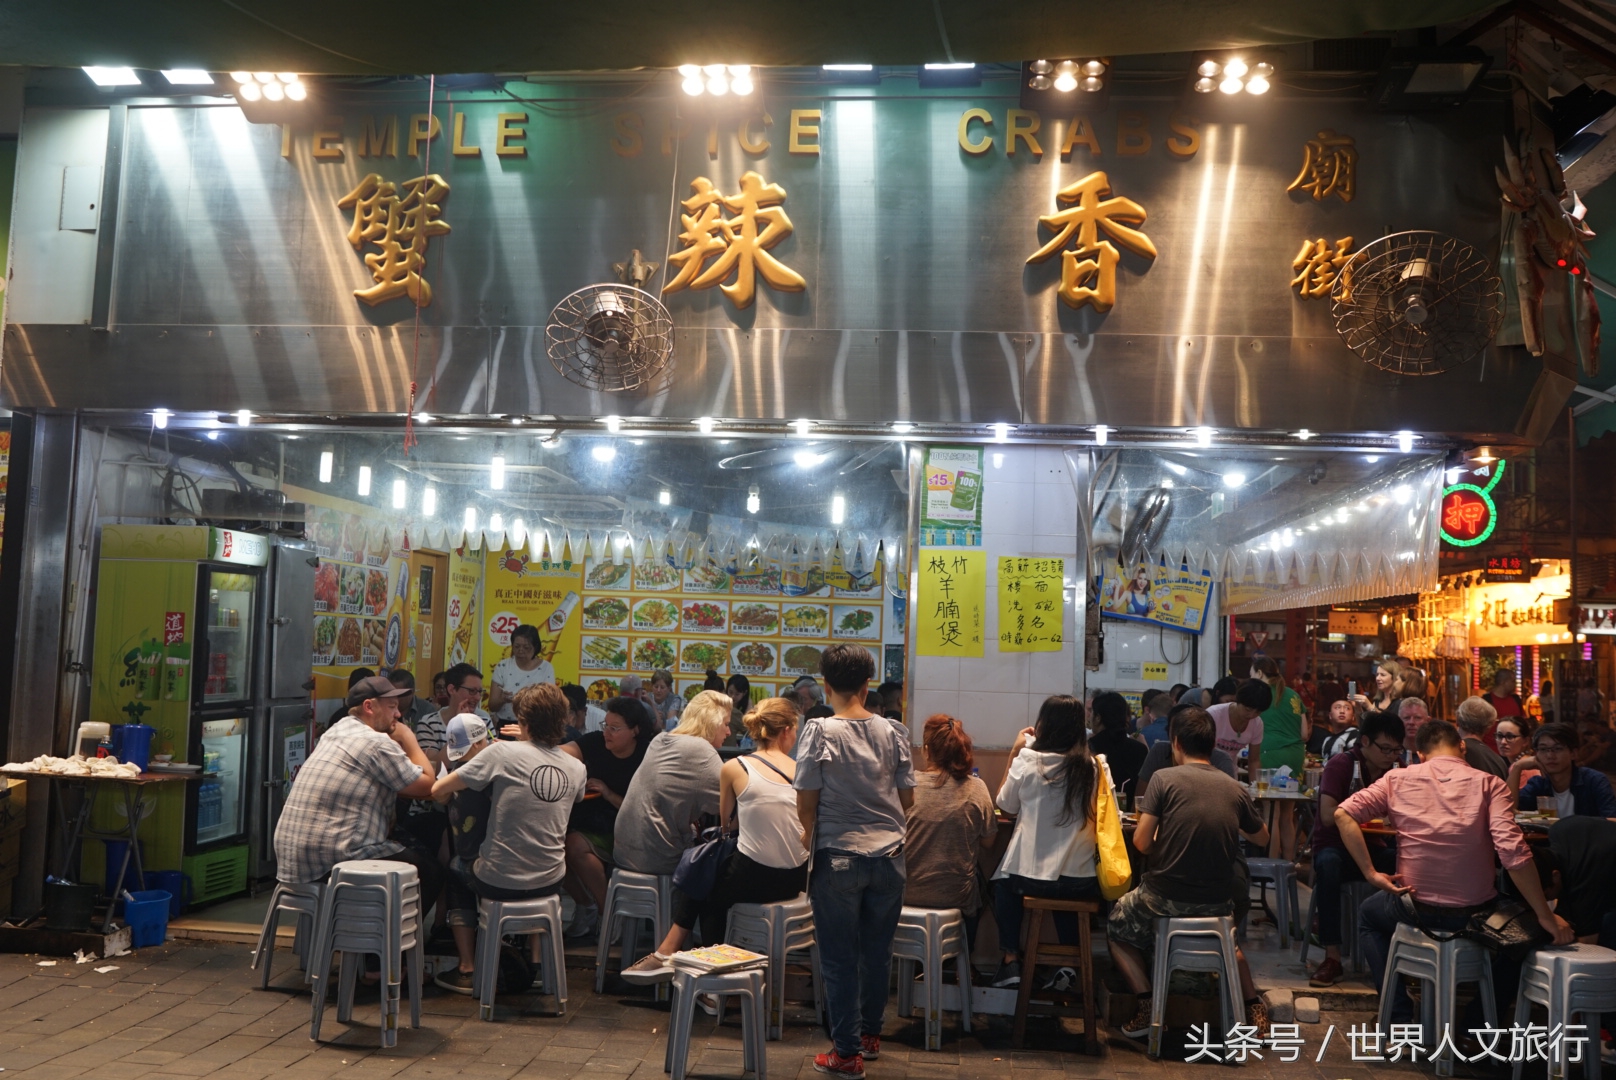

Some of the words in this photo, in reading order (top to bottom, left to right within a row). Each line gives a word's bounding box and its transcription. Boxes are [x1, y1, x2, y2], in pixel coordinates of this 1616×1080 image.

[610, 109, 822, 158] SPICE
[957, 107, 1201, 159] CRABS
[1445, 495, 1485, 534] 押
[495, 589, 562, 600] 真正中國好滋味
[164, 612, 185, 646] 道地
[490, 616, 519, 634] $25
